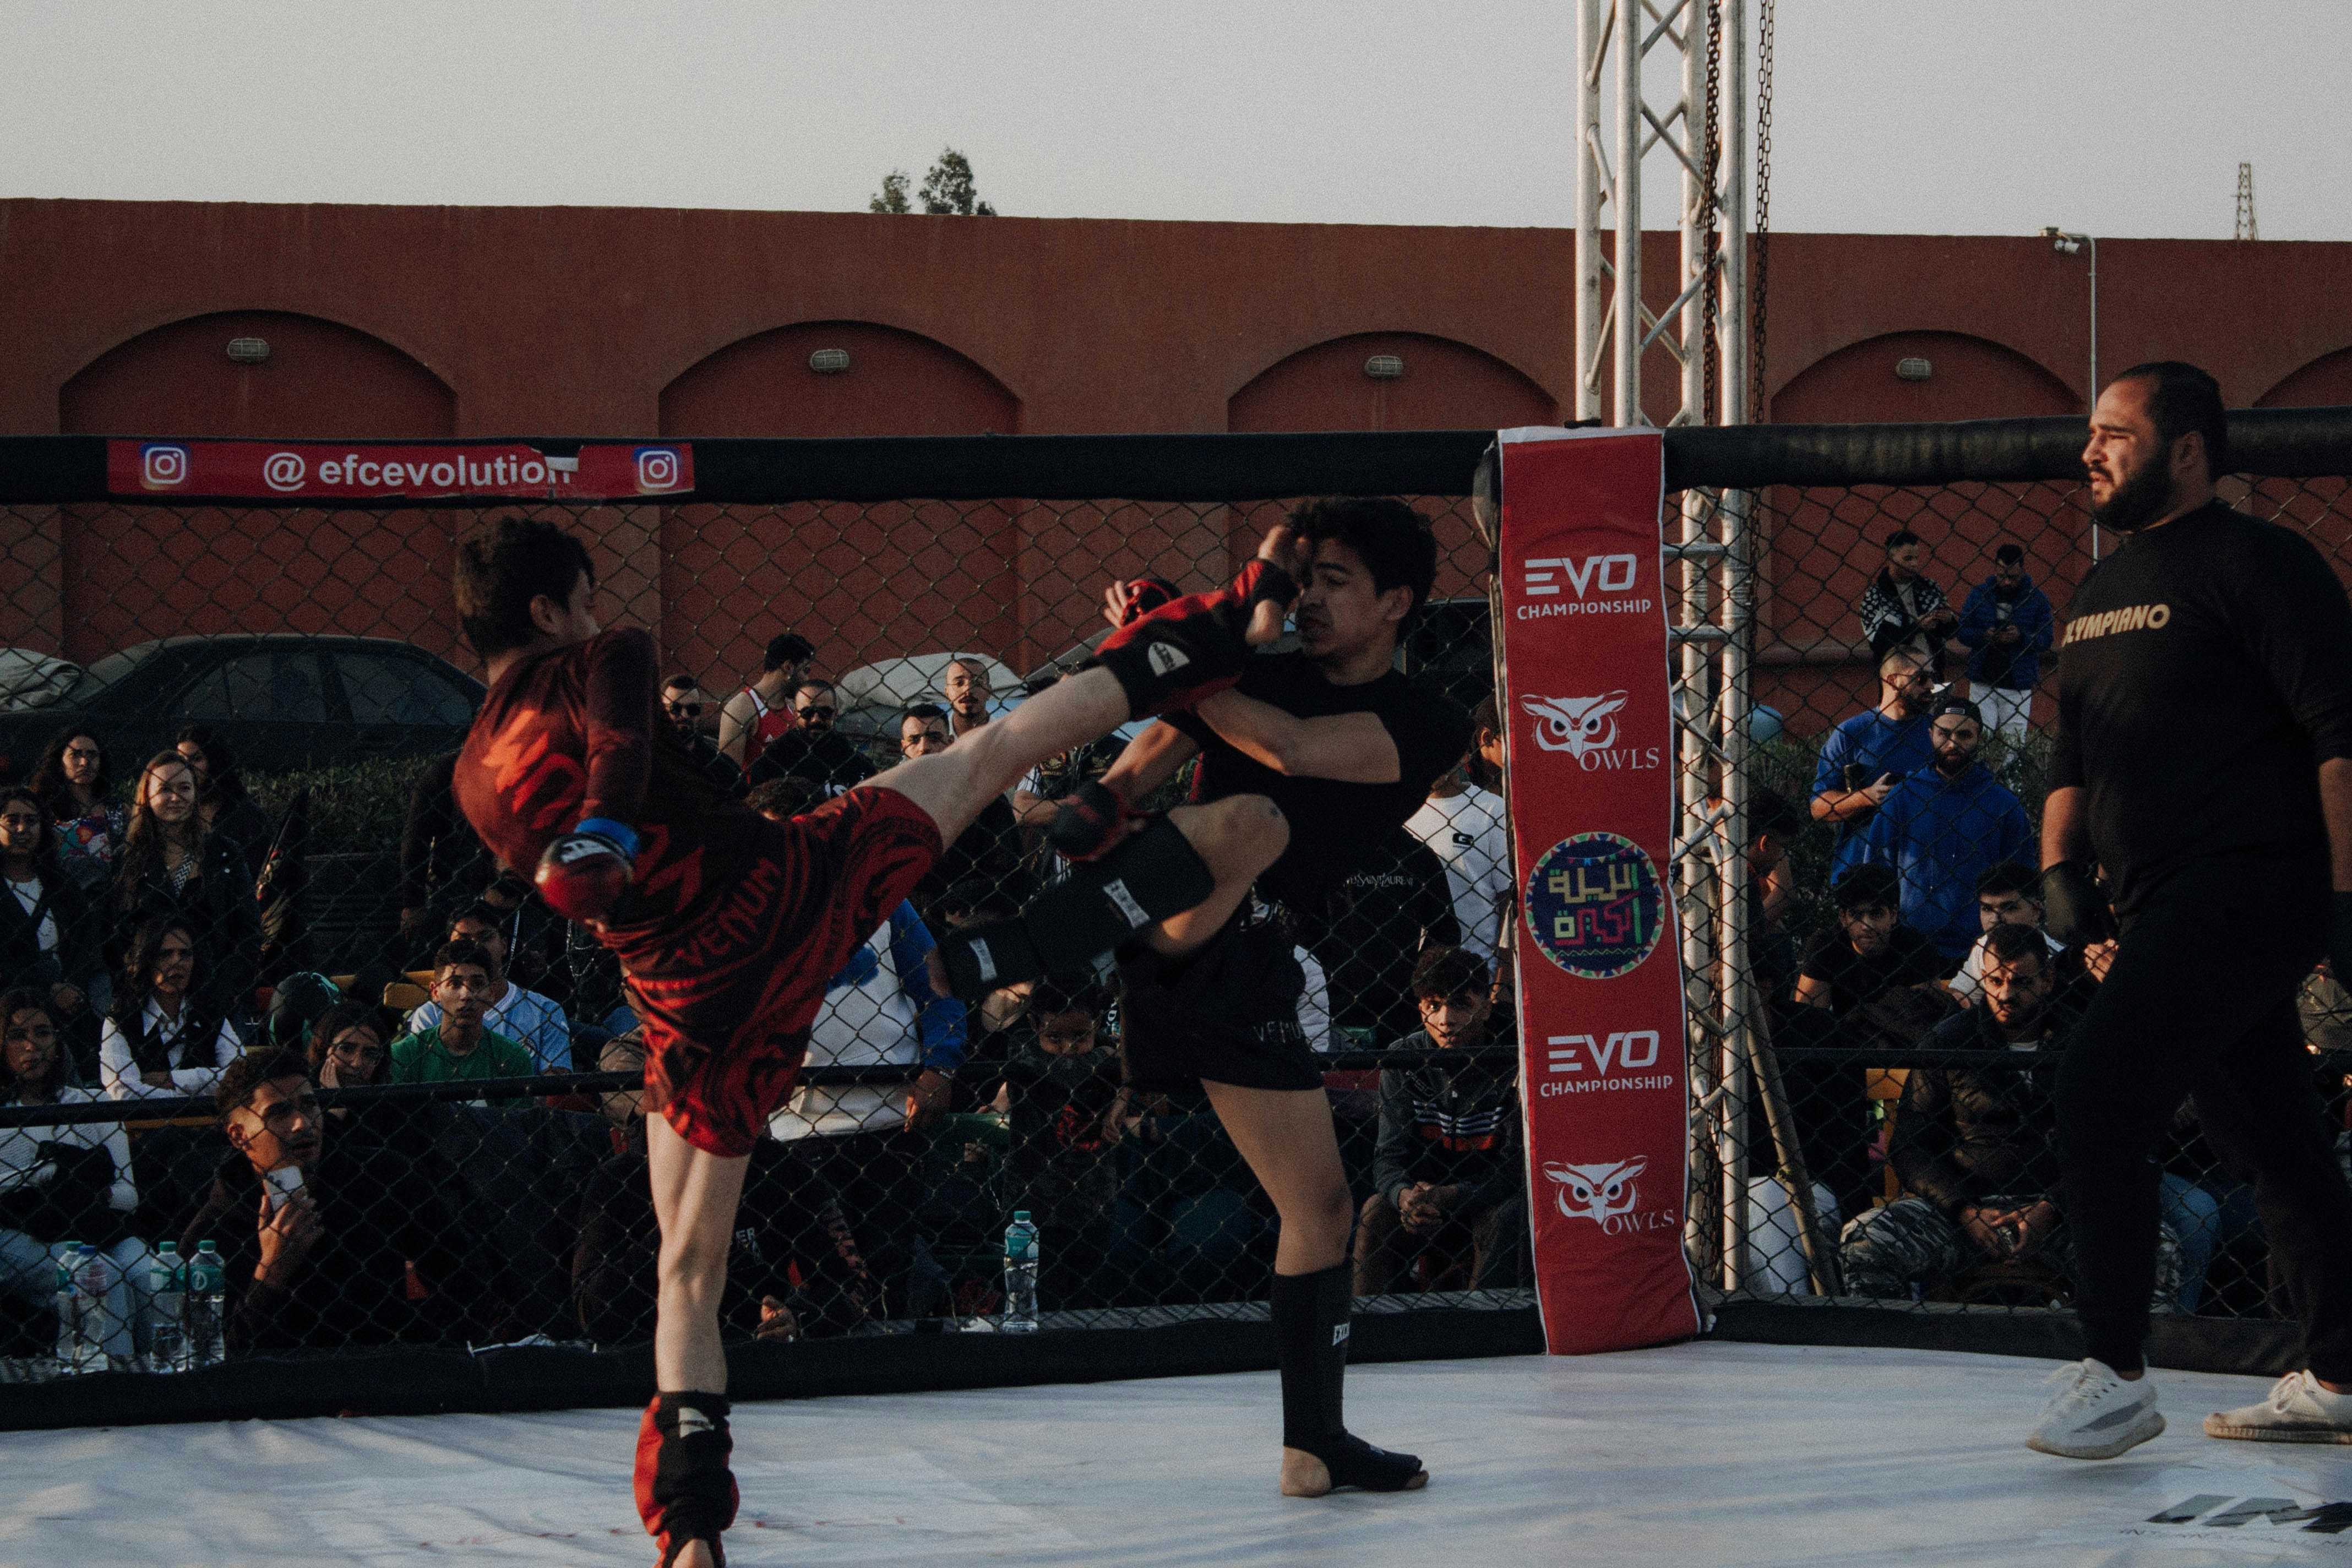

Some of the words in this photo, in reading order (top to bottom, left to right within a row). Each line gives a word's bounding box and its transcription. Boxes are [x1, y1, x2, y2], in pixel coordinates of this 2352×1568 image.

[1525, 553, 1637, 600] EVO
[1516, 598, 1652, 620] CHAMPIONSHIP
[1579, 748, 1659, 771] OWLS
[1548, 1030, 1659, 1076] EVO
[1540, 1075, 1673, 1097] CHAMPIONSHIP
[1602, 1209, 1675, 1235] OWLS
